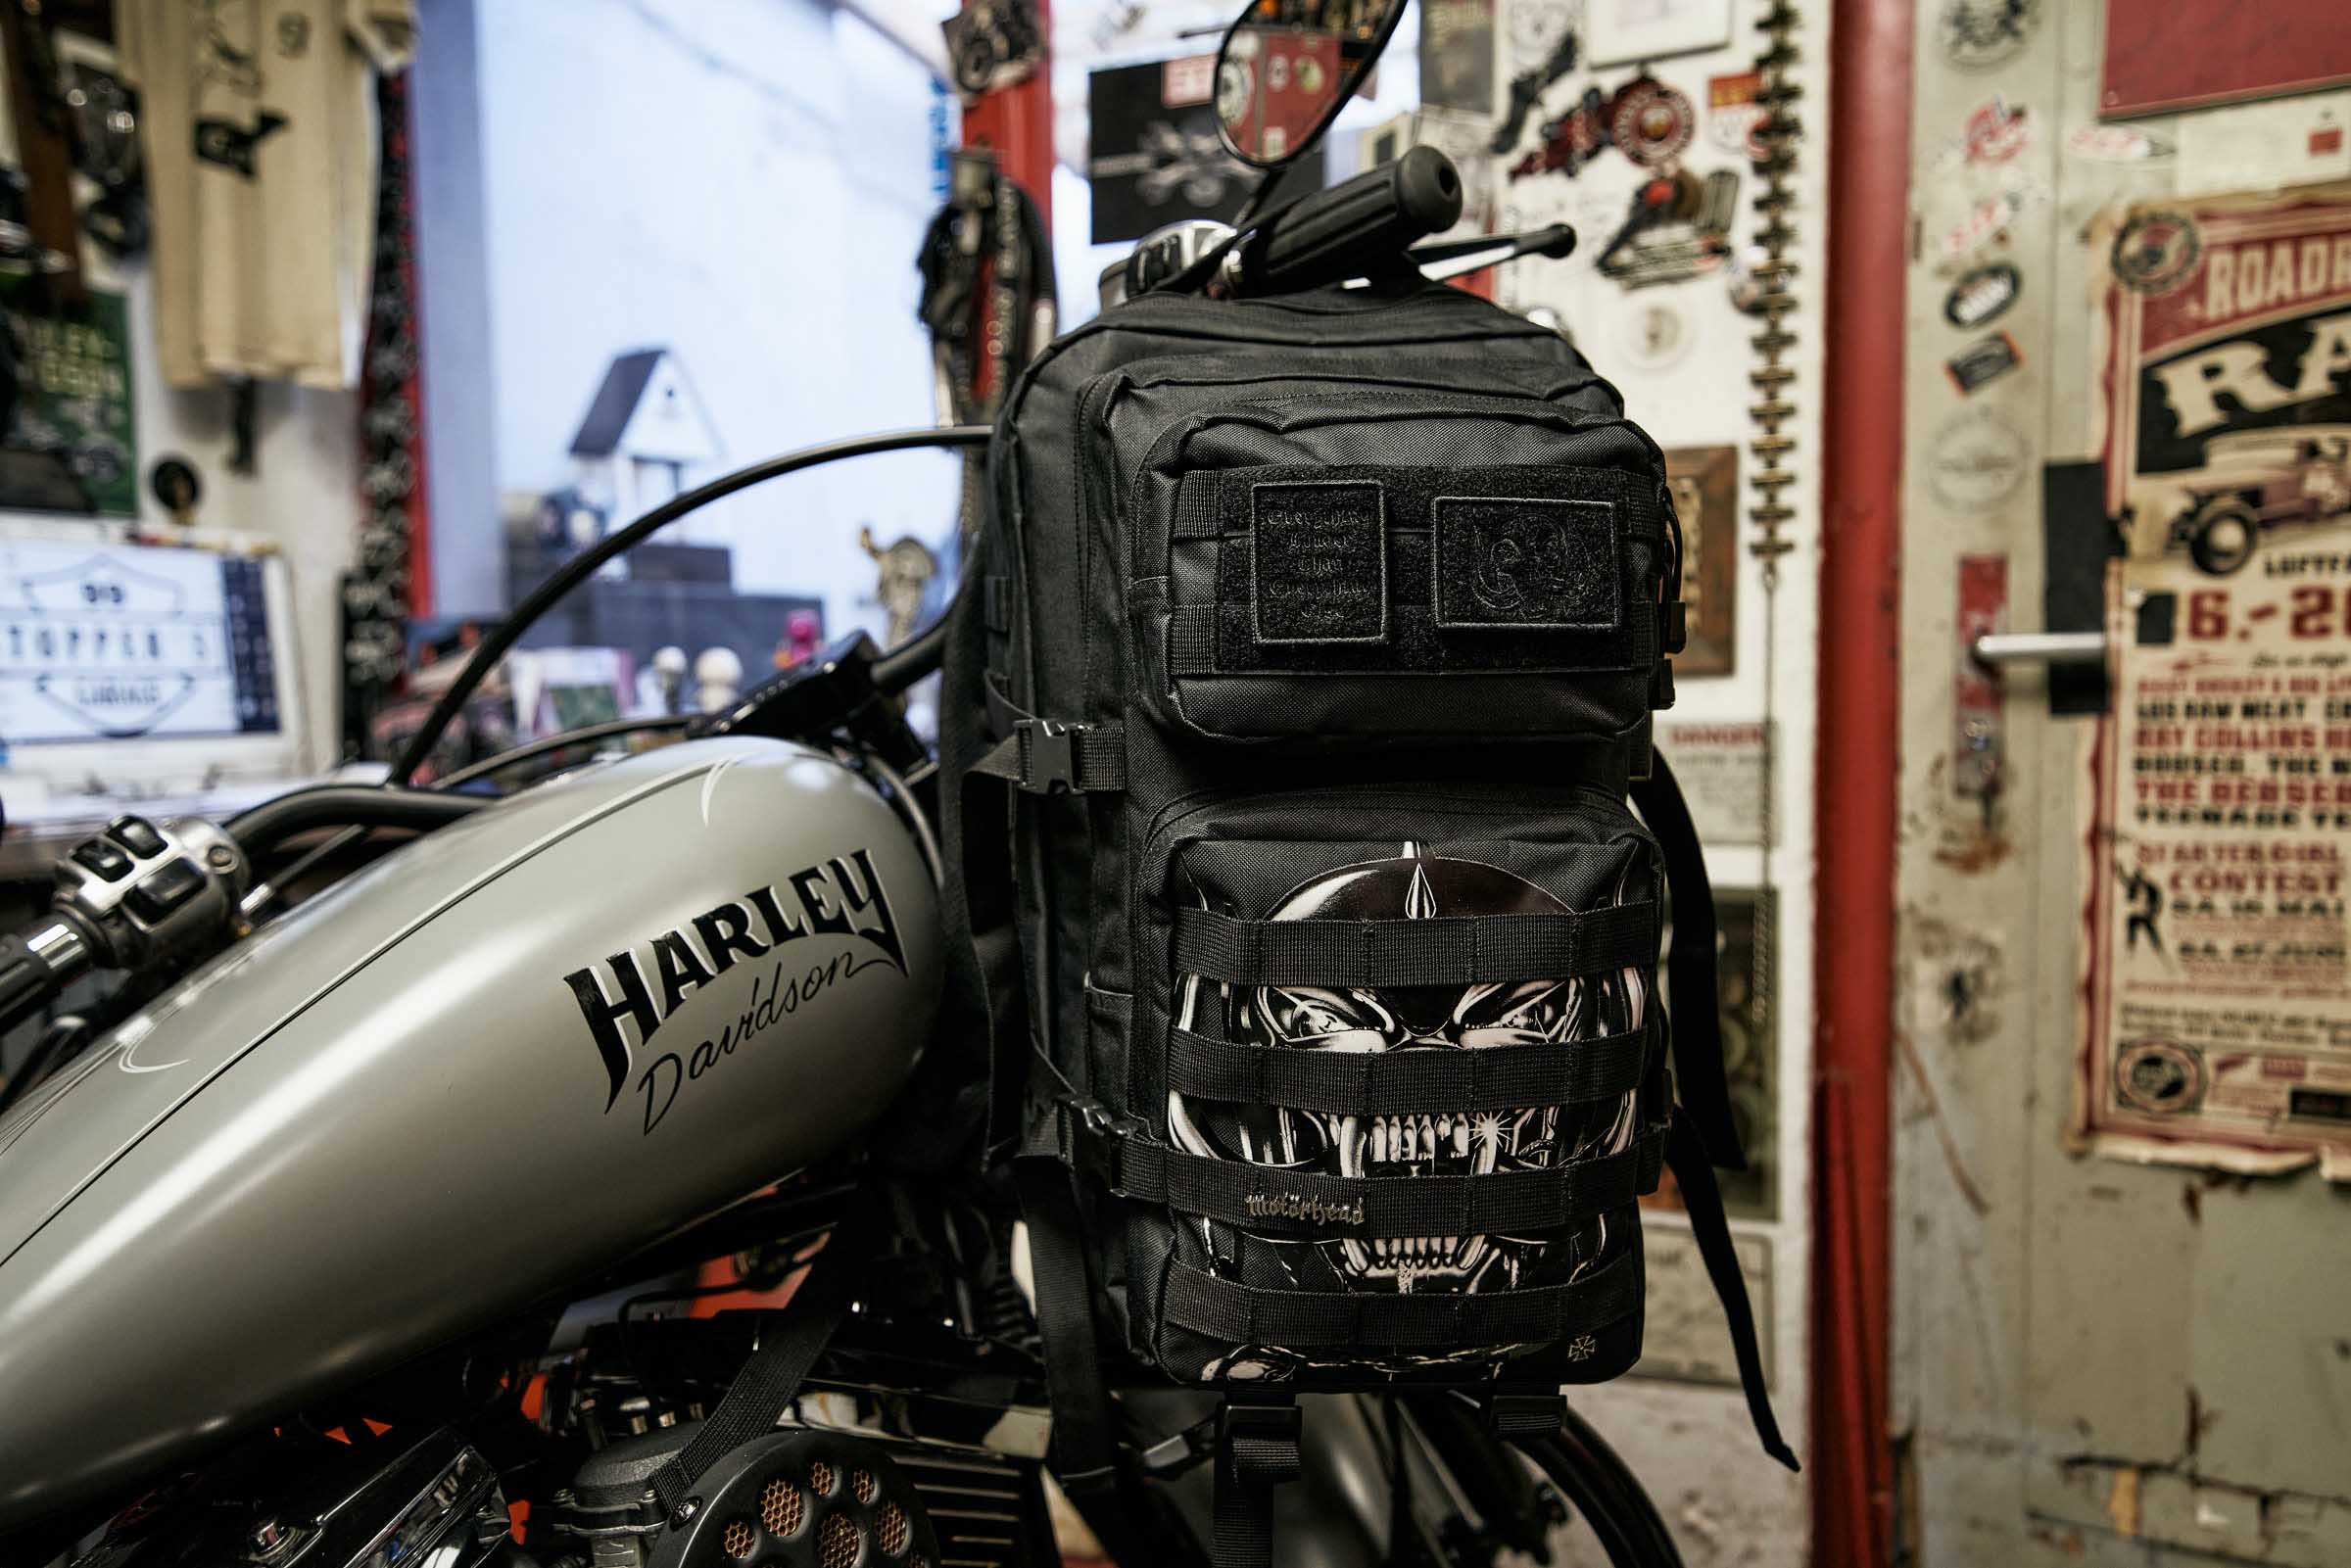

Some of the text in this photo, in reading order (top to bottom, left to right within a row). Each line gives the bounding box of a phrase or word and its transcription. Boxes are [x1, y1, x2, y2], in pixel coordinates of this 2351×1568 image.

[2169, 871, 2338, 893] CONTEST
[563, 848, 908, 1115] HARLEY
[637, 951, 898, 1136] Davidson
